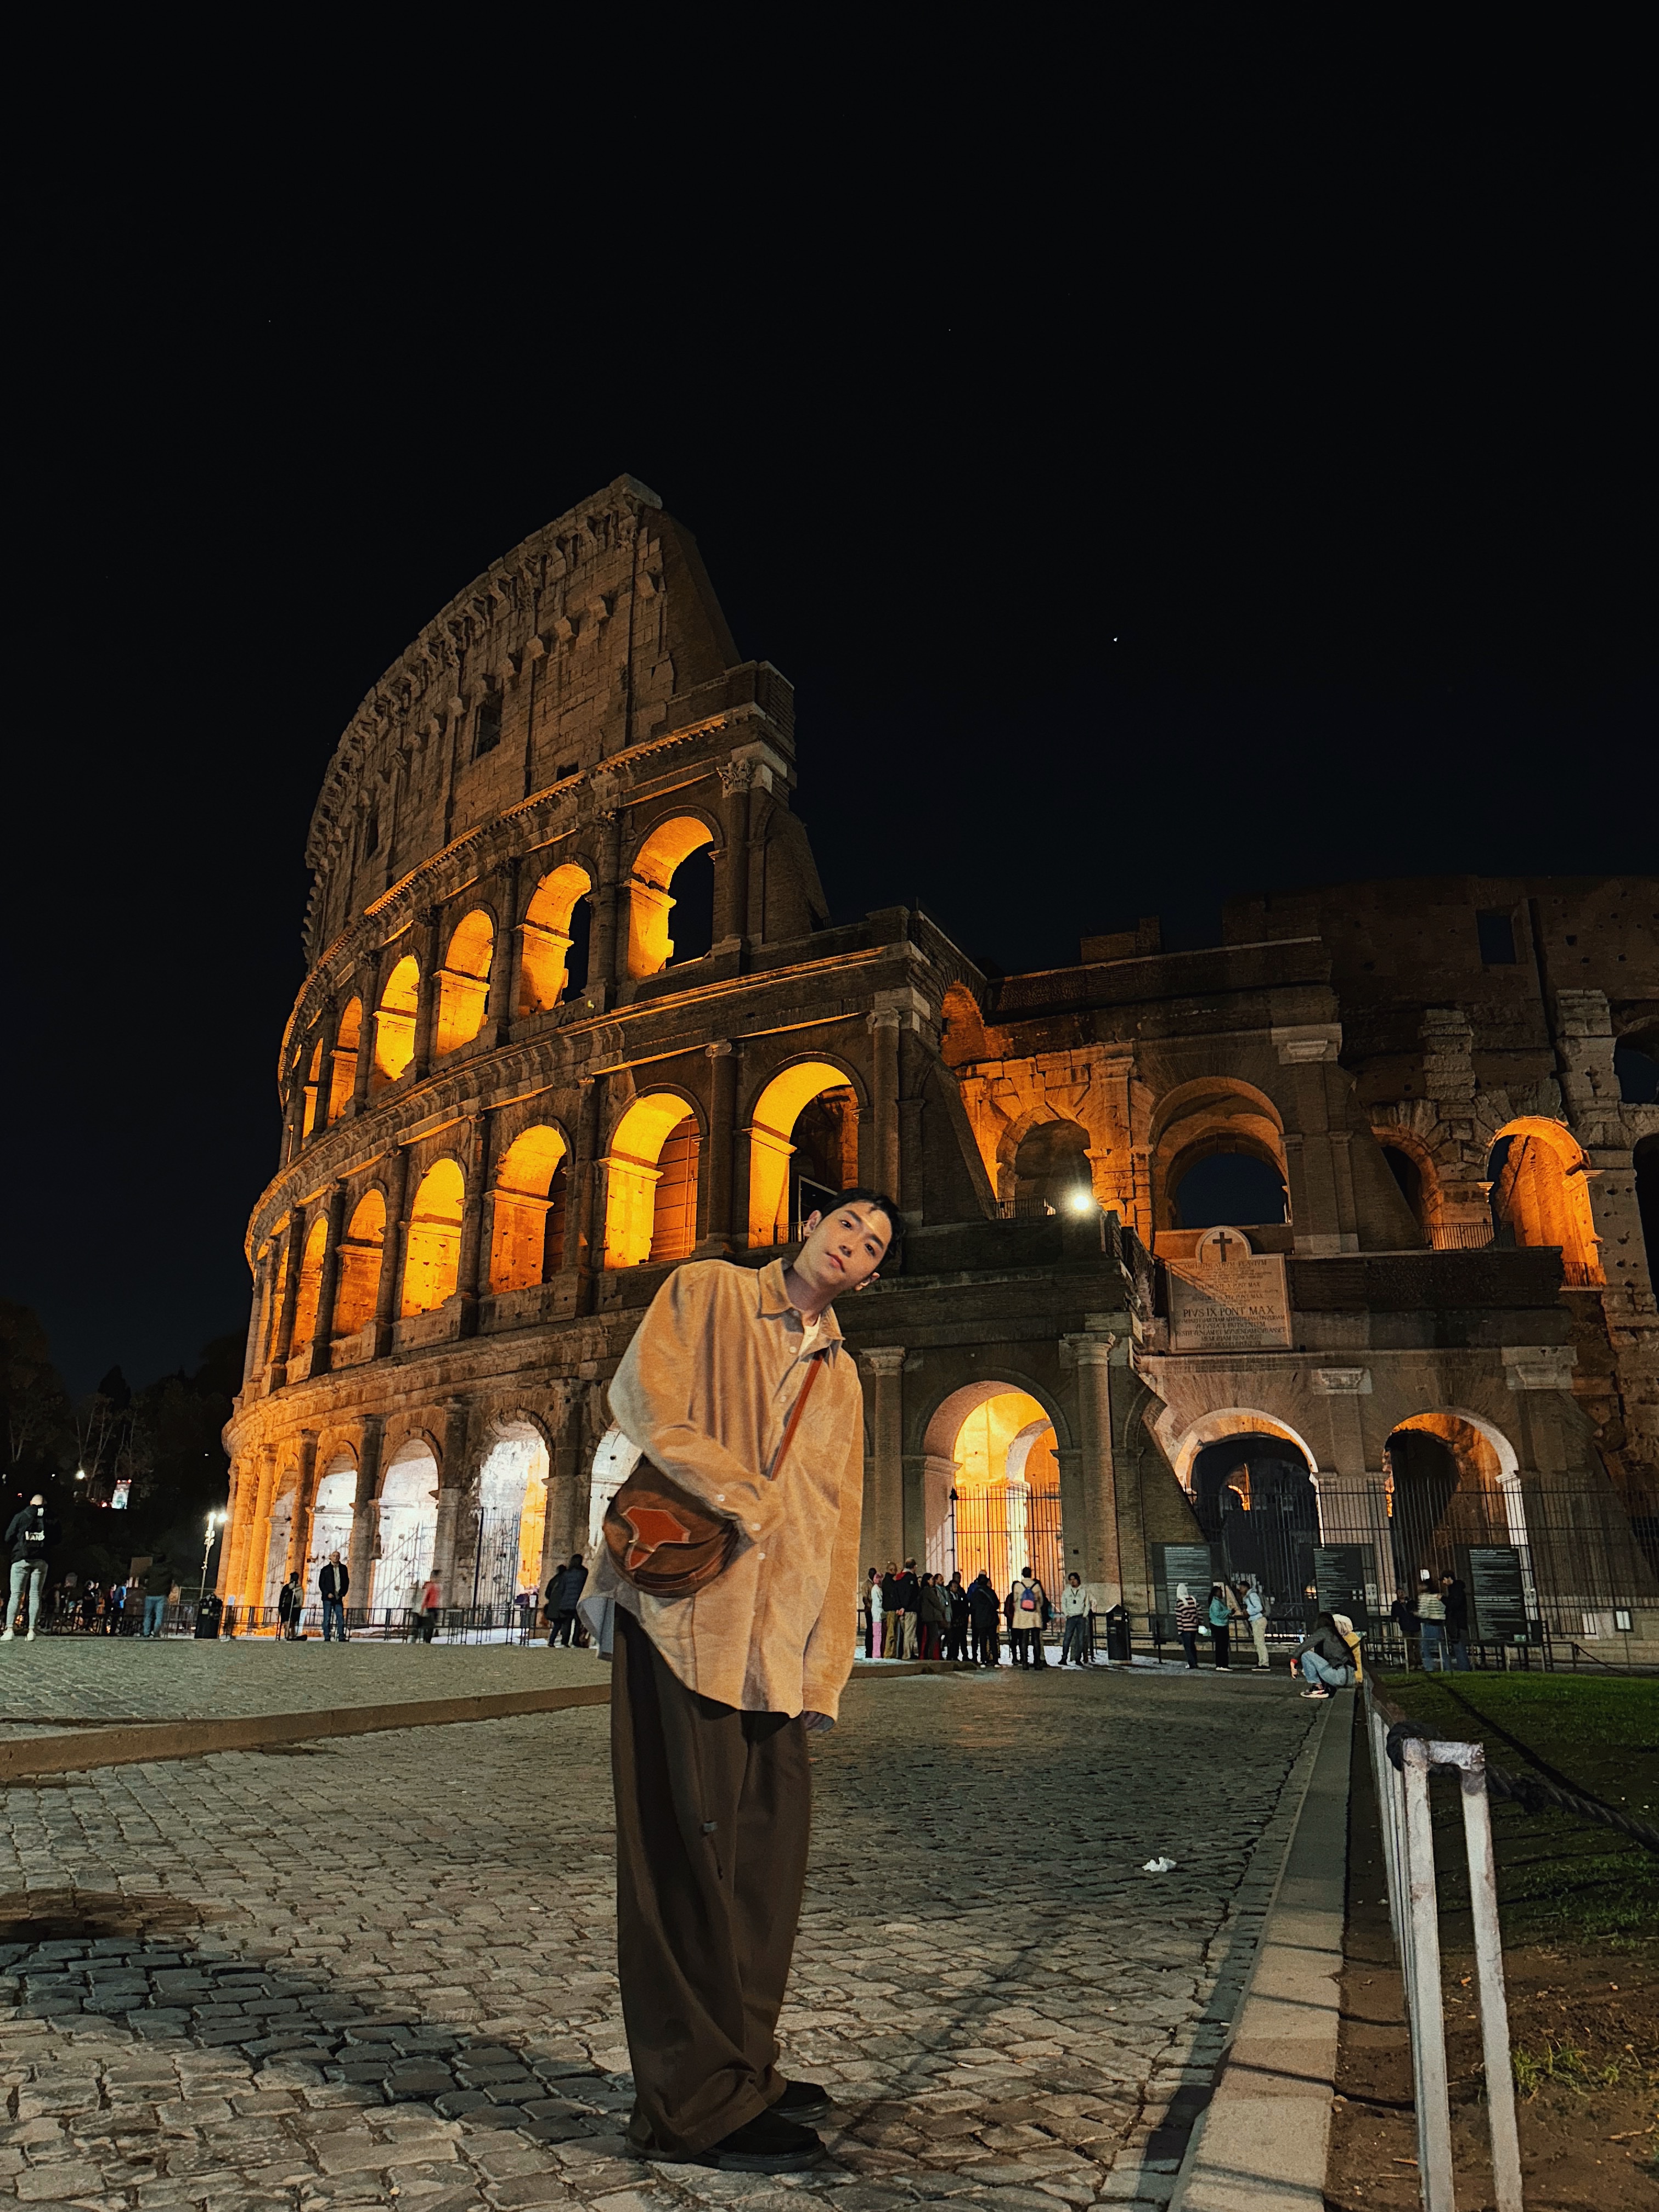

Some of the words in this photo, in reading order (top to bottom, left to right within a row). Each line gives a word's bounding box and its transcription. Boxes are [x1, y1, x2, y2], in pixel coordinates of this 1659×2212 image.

[1207, 1307, 1217, 1317] IX
[1220, 1306, 1244, 1316] PONT
[1249, 1305, 1274, 1316] MAX
[25, 1530, 45, 1541] VANS
